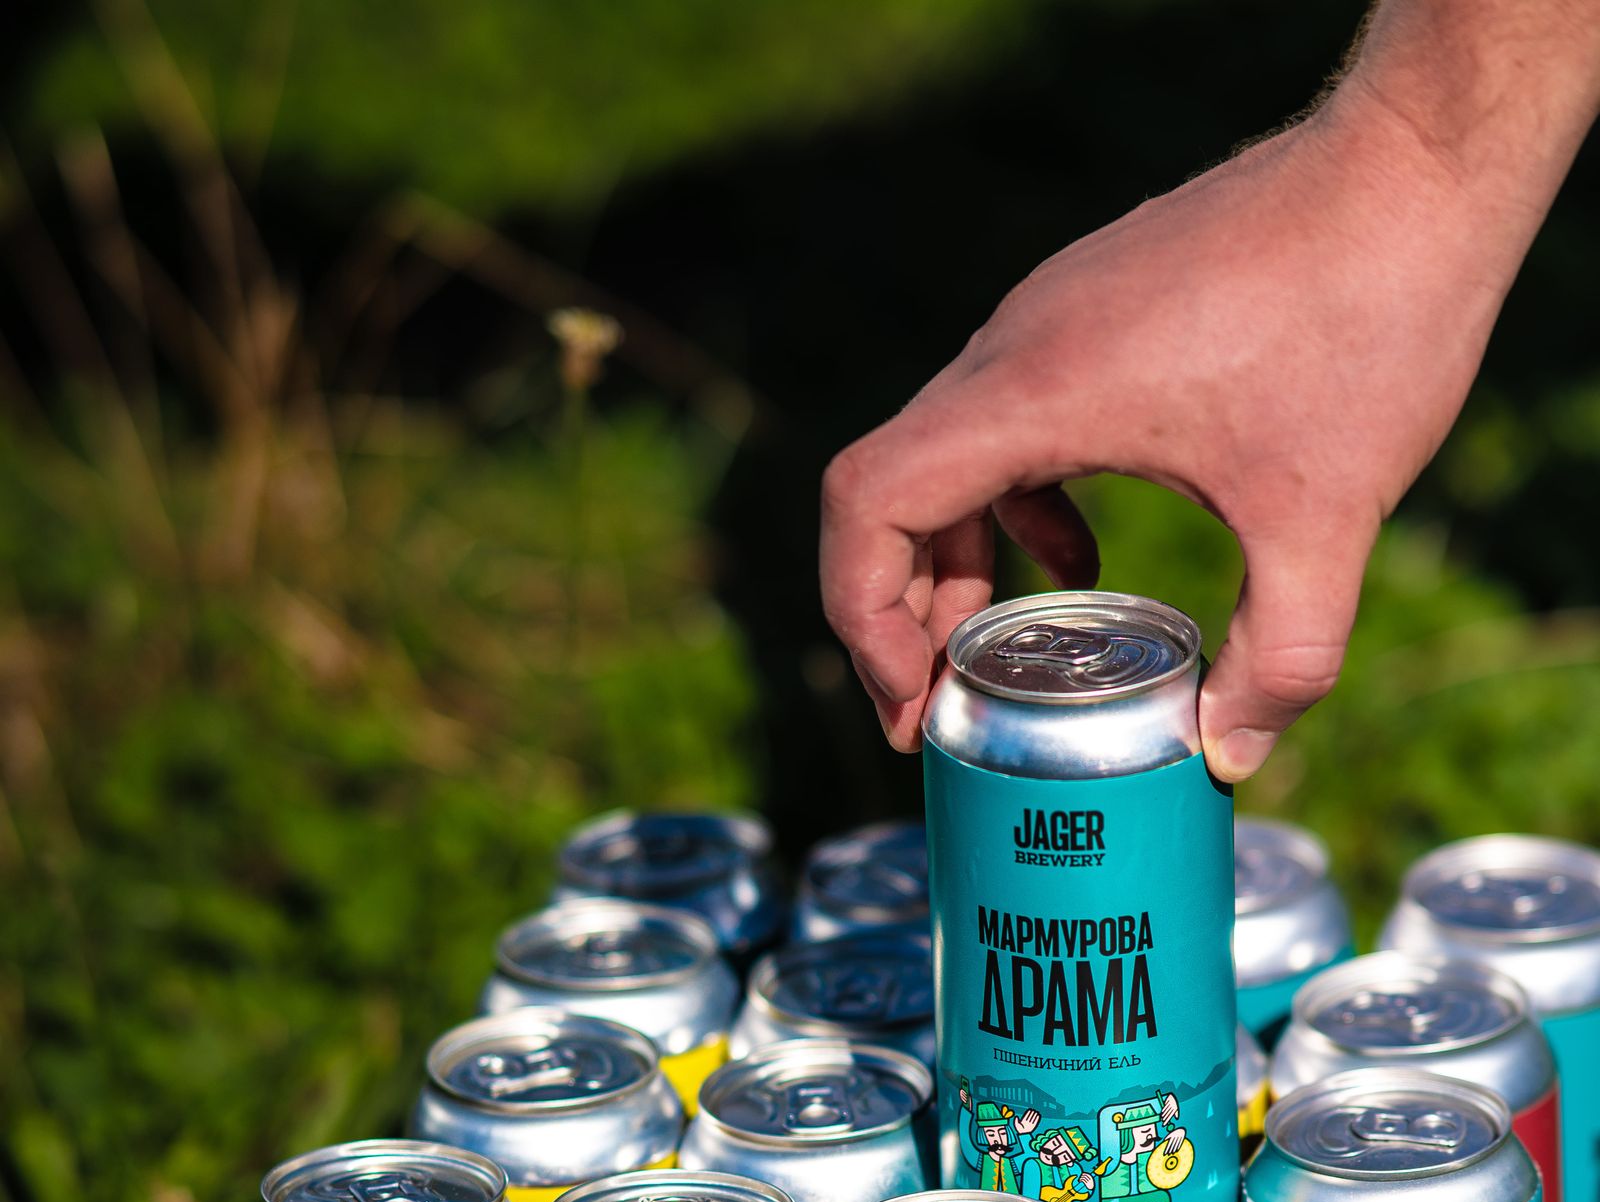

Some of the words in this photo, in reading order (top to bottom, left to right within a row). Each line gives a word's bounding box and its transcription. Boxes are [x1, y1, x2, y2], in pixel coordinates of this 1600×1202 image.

[1014, 808, 1106, 851] JAGER
[1014, 850, 1106, 867] BREWERY
[978, 904, 1154, 958] МАРМУРОВА
[978, 949, 1158, 1047] ДРАМА
[993, 1047, 1102, 1071] ПШЕНИЧНИЙ
[1108, 1054, 1142, 1070] ЕЛЬ
